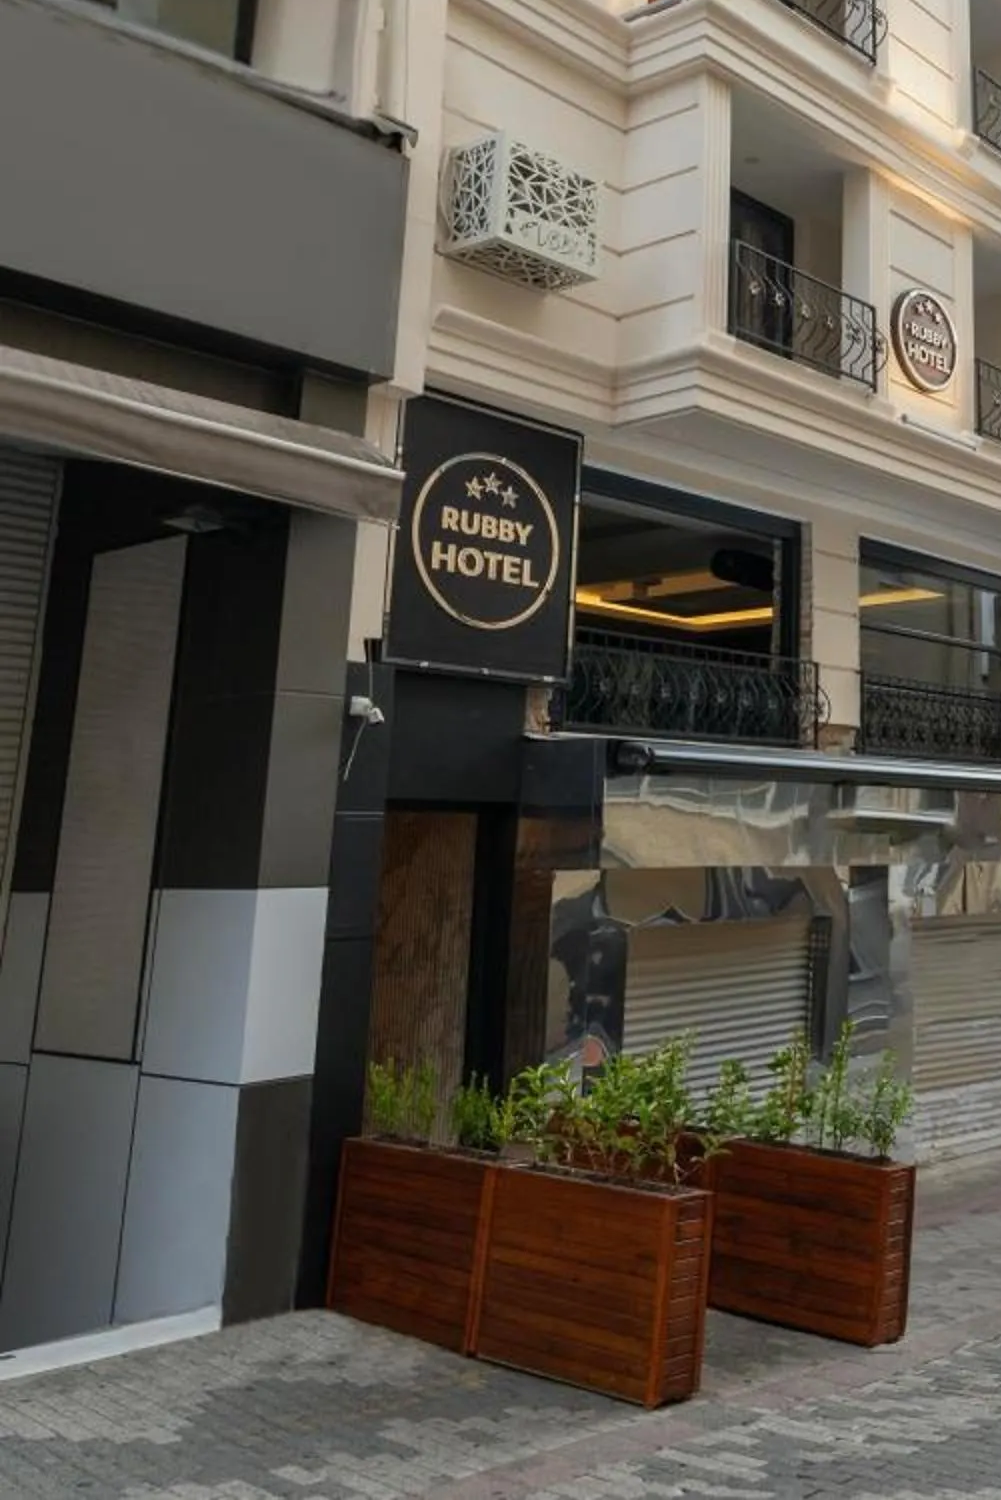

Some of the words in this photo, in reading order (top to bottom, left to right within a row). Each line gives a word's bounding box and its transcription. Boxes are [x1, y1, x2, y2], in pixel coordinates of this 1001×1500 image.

[910, 322, 949, 349] RUBBY
[907, 342, 951, 375] HOTEL
[440, 505, 534, 546] RUBBY
[430, 540, 540, 588] HOTEL
